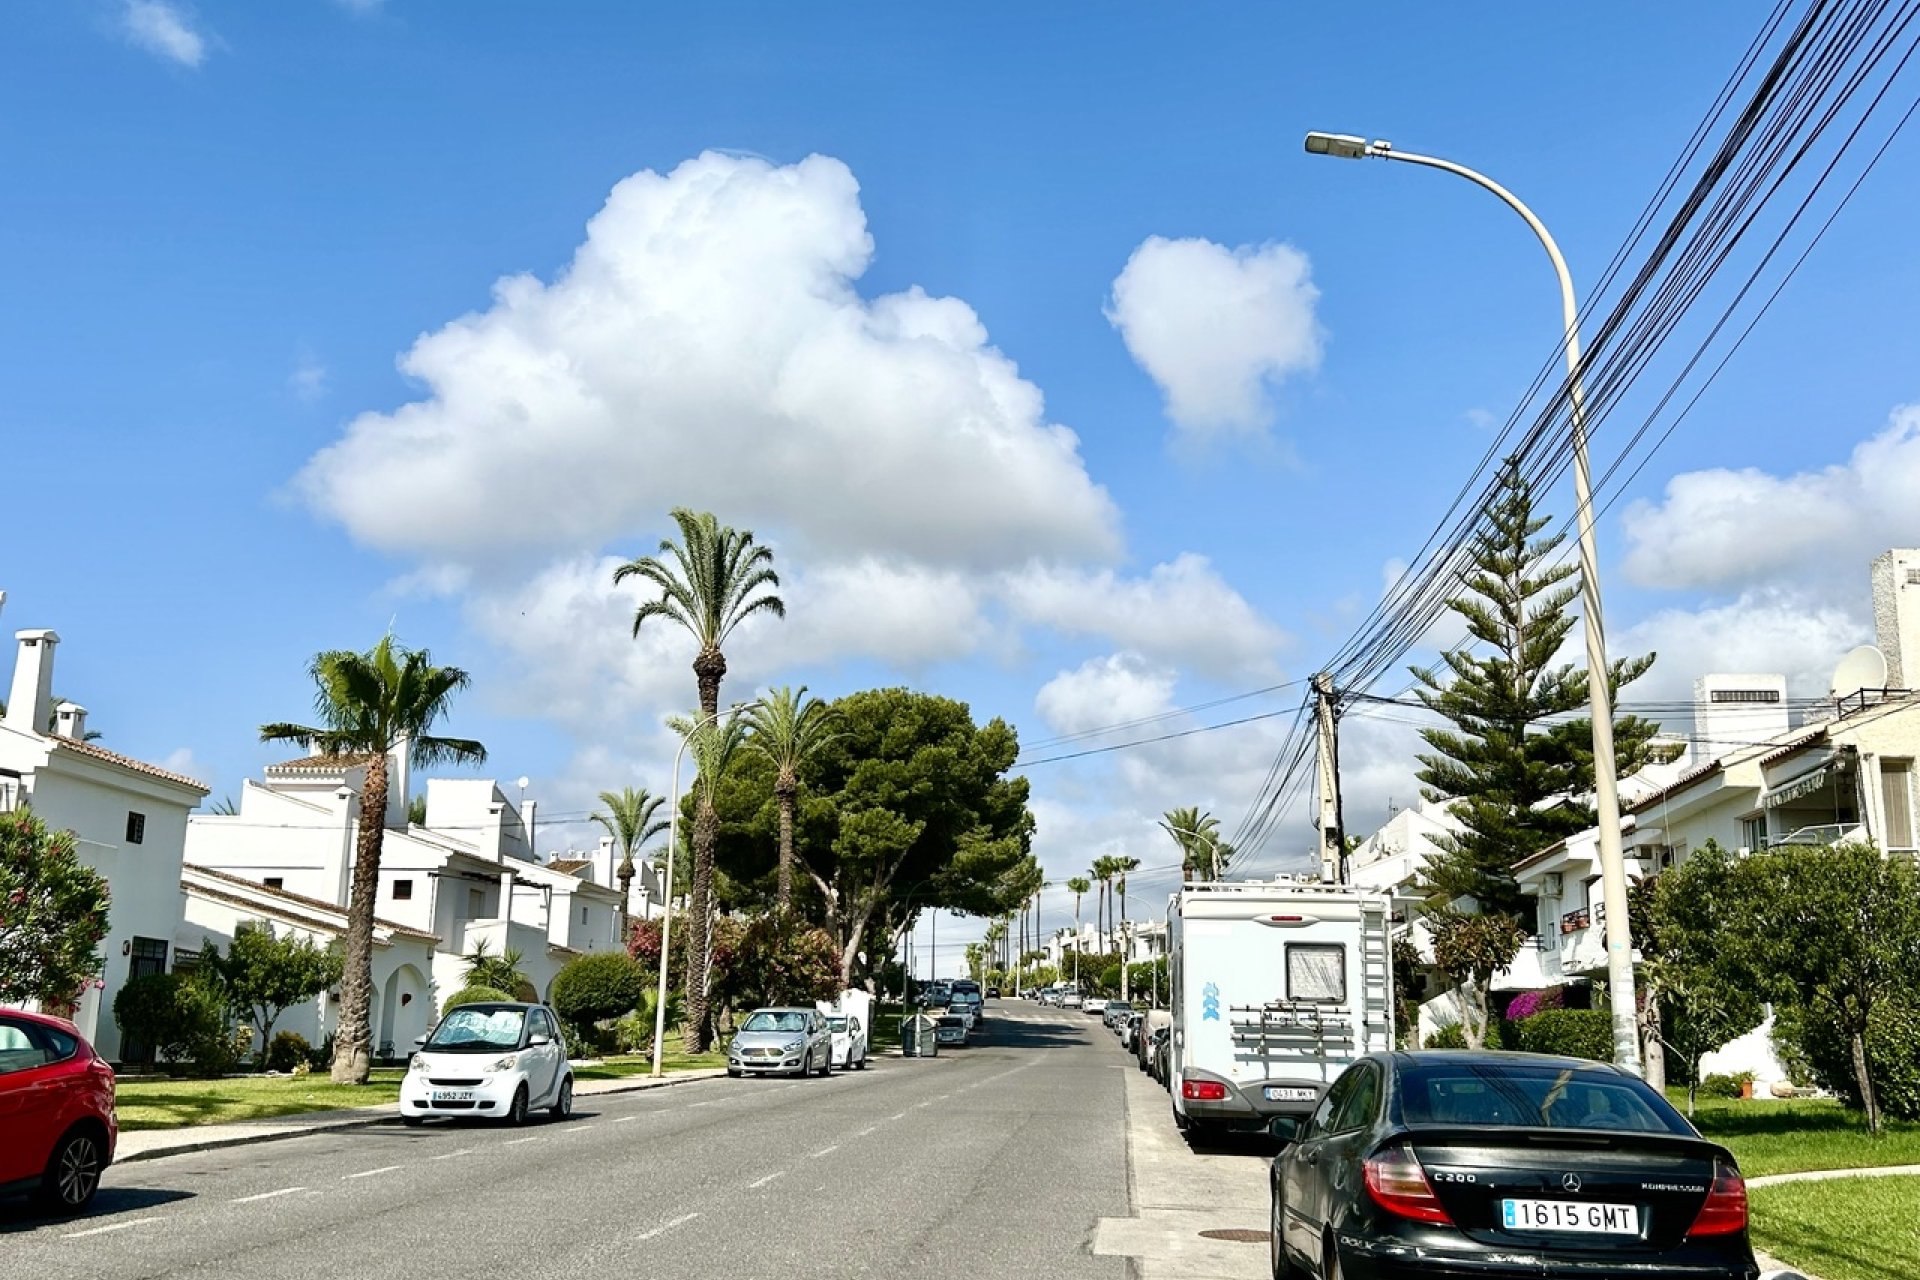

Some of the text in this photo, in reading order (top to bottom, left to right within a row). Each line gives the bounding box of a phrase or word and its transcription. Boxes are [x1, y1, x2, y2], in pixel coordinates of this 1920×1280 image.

[1434, 1173, 1476, 1183] C 200
[1522, 1203, 1630, 1229] 1615 GMT
